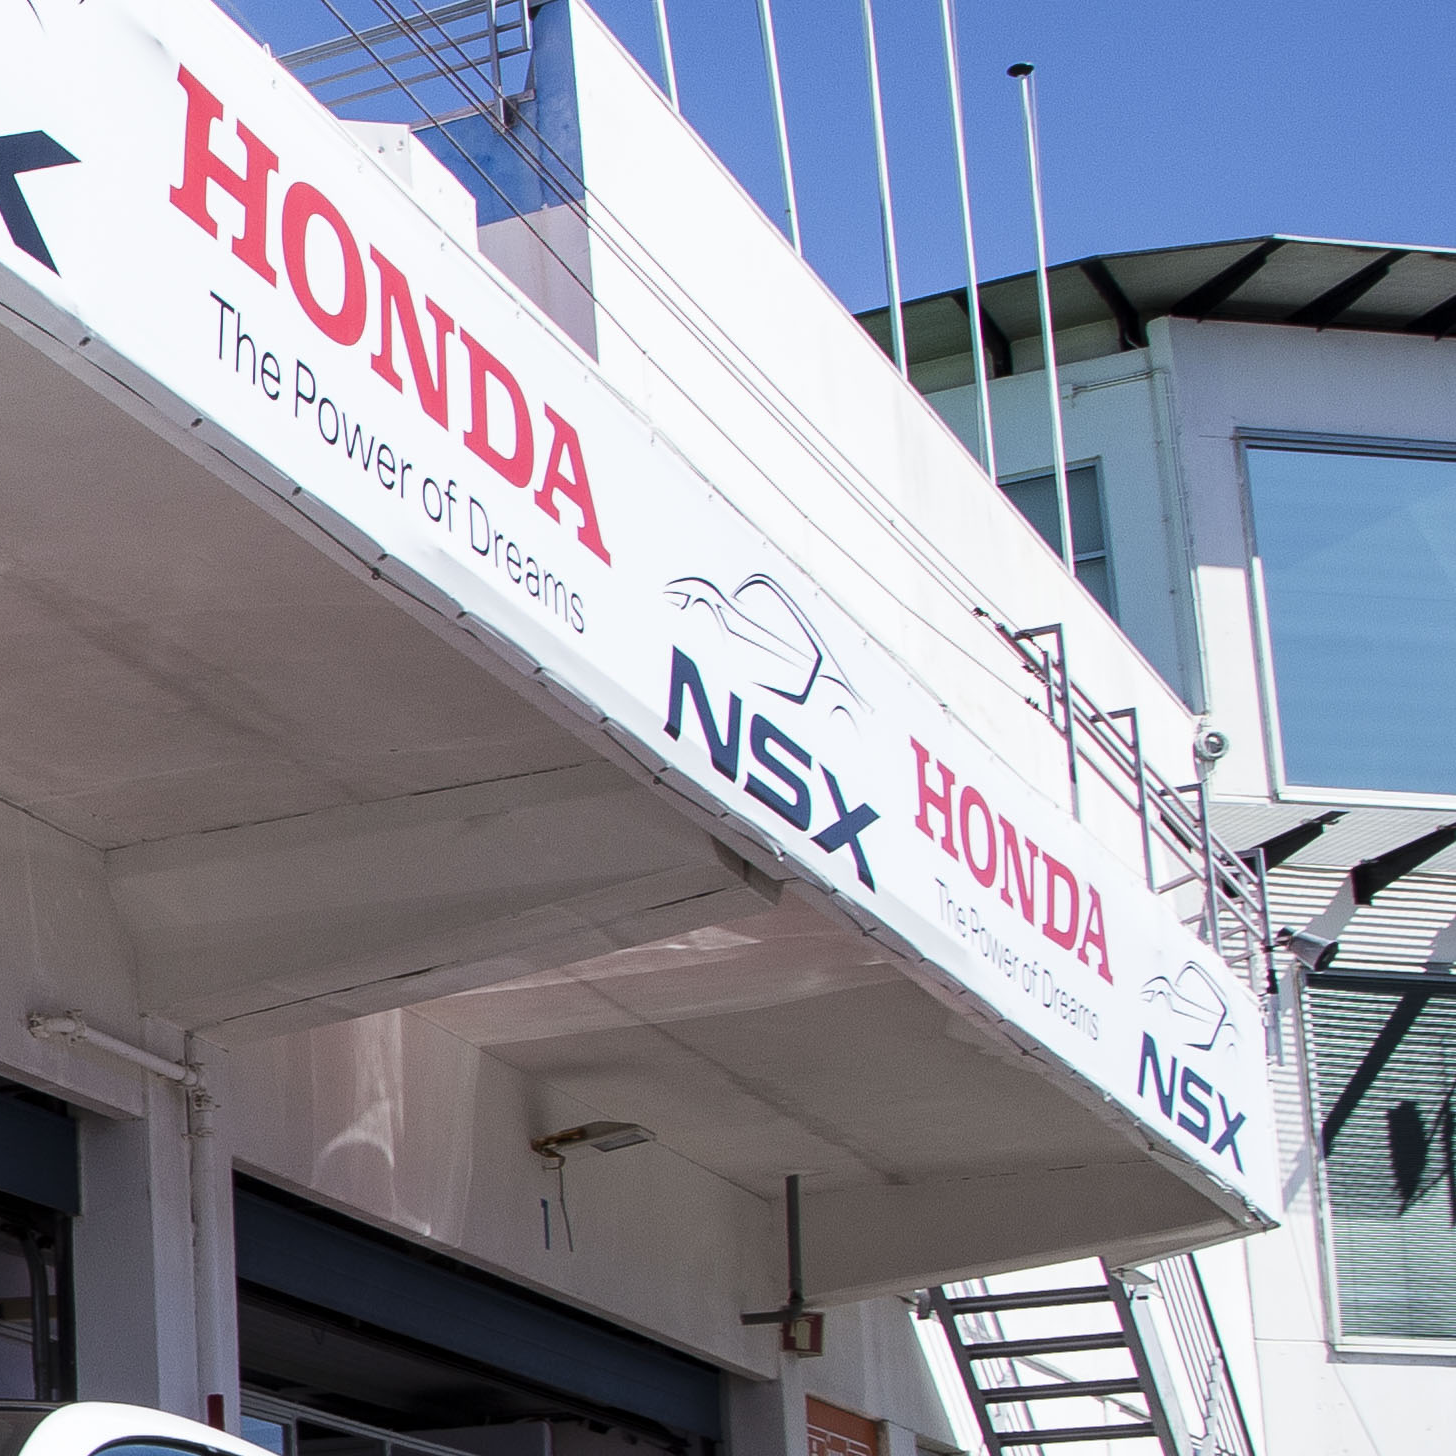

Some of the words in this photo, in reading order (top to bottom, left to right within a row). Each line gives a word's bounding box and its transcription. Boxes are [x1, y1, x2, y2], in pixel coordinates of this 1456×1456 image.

[169, 63, 611, 567] HONDA
[210, 291, 281, 400] The
[295, 359, 412, 499] Power
[423, 478, 457, 533] of
[469, 496, 585, 633] Dreams
[663, 644, 880, 892] NSX
[909, 735, 1114, 986] HONDA
[935, 878, 966, 938] The
[970, 907, 1019, 982] Power
[1022, 961, 1038, 998] of
[1042, 968, 1099, 1041] Dreams
[1137, 1032, 1246, 1175] NSX
